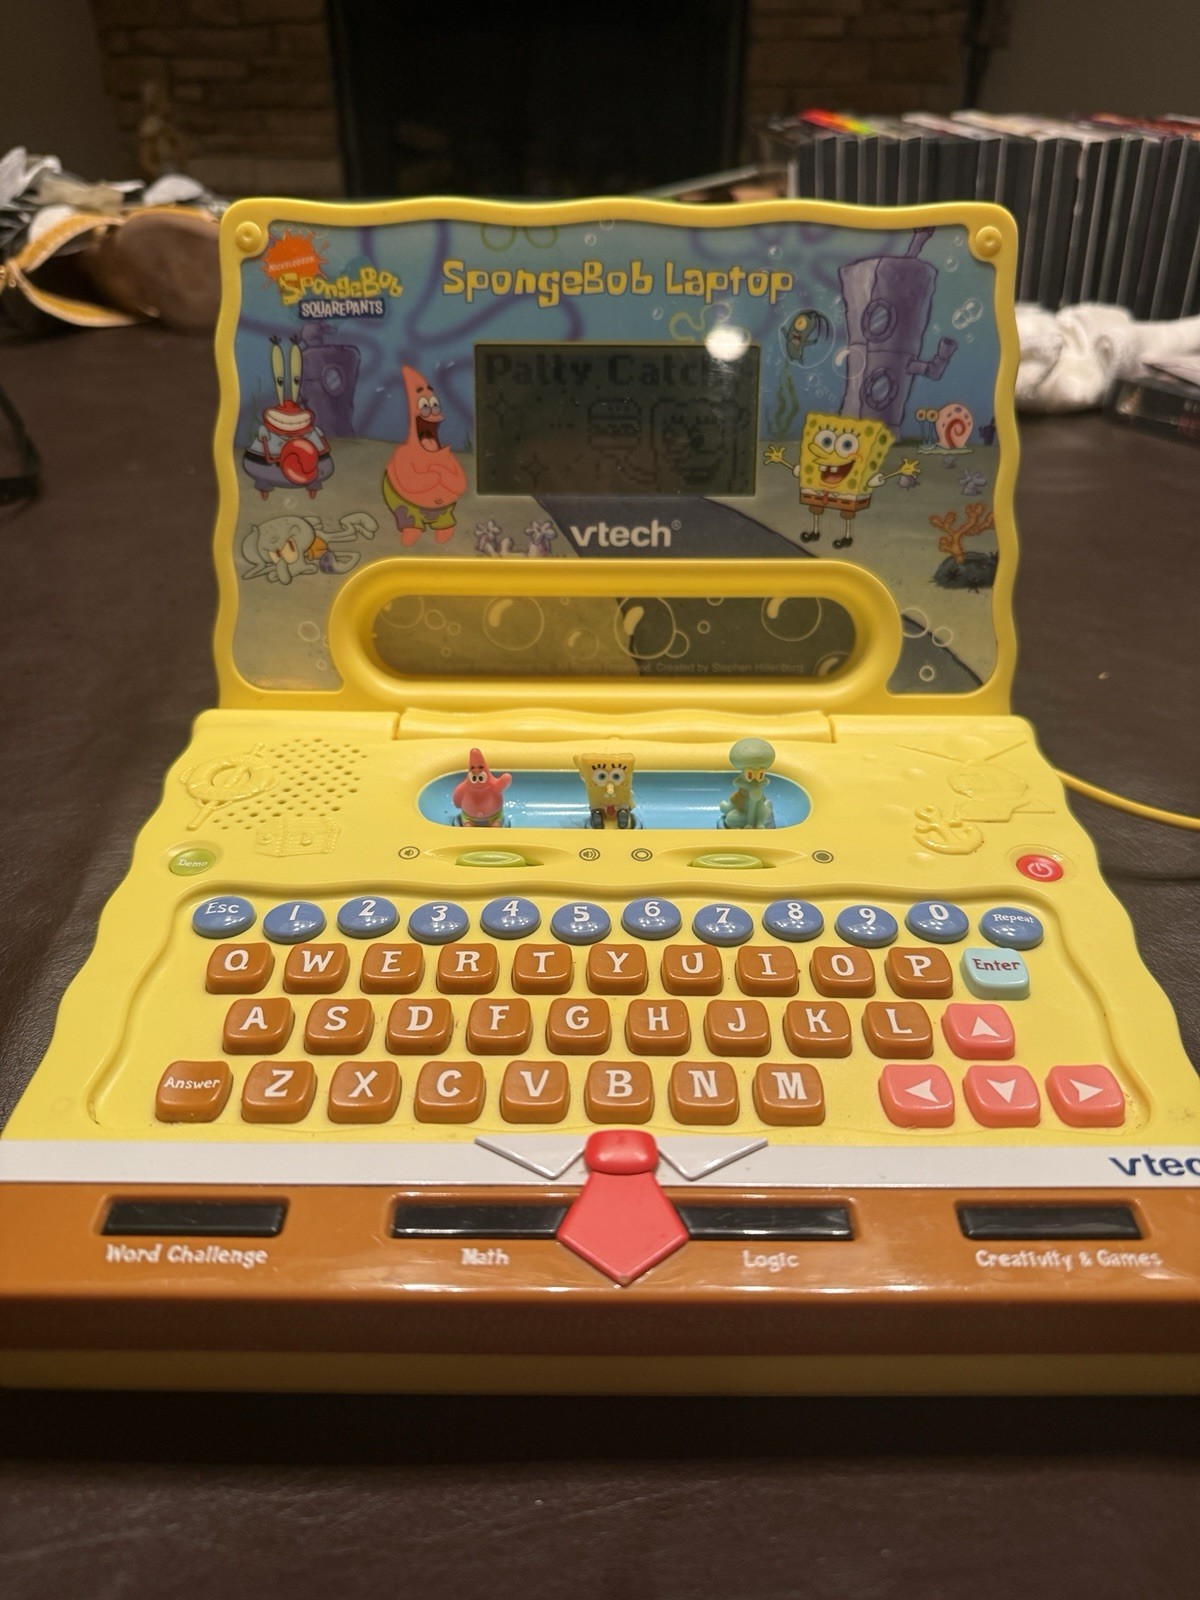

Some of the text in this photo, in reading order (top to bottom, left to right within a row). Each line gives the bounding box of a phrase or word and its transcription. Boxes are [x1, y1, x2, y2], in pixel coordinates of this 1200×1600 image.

[442, 260, 794, 308] SpongeBob Laptop
[301, 300, 384, 318] SQUAREPANTS
[569, 520, 673, 547] vtech
[176, 857, 208, 868] Demo
[204, 901, 239, 916] Esc
[359, 900, 375, 916] 2
[431, 905, 447, 921] 3
[503, 900, 518, 916] 4
[573, 906, 590, 922] 5
[645, 901, 661, 918] 6
[716, 908, 730, 924] 7
[788, 903, 803, 919] 8
[859, 908, 876, 926] 9
[992, 912, 1035, 926] Repeat
[225, 950, 248, 971] Q
[302, 951, 334, 972] W
[381, 951, 401, 972] E
[455, 951, 479, 971] R
[533, 952, 554, 972] T
[607, 951, 628, 972] Y
[682, 953, 703, 973] U
[904, 955, 931, 976] P
[973, 958, 1021, 972] Enter
[239, 1007, 267, 1030] A
[324, 1006, 349, 1030] S
[407, 1006, 432, 1030] D
[489, 1006, 509, 1030] F
[566, 1006, 589, 1029] G
[648, 1007, 668, 1030] H
[728, 1008, 745, 1031] J
[806, 1009, 831, 1032] K
[888, 1009, 913, 1033] L
[163, 1075, 221, 1091] Answer
[264, 1070, 293, 1097] Z
[348, 1070, 377, 1097] X
[437, 1070, 461, 1097] C
[520, 1070, 549, 1096] V
[606, 1070, 632, 1097] B
[689, 1071, 717, 1097] N
[771, 1072, 806, 1099] M
[106, 1244, 268, 1266] Word Challenge
[461, 1247, 510, 1266] Math
[742, 1250, 799, 1271] Logic
[975, 1249, 1164, 1272] Creativity & Games
